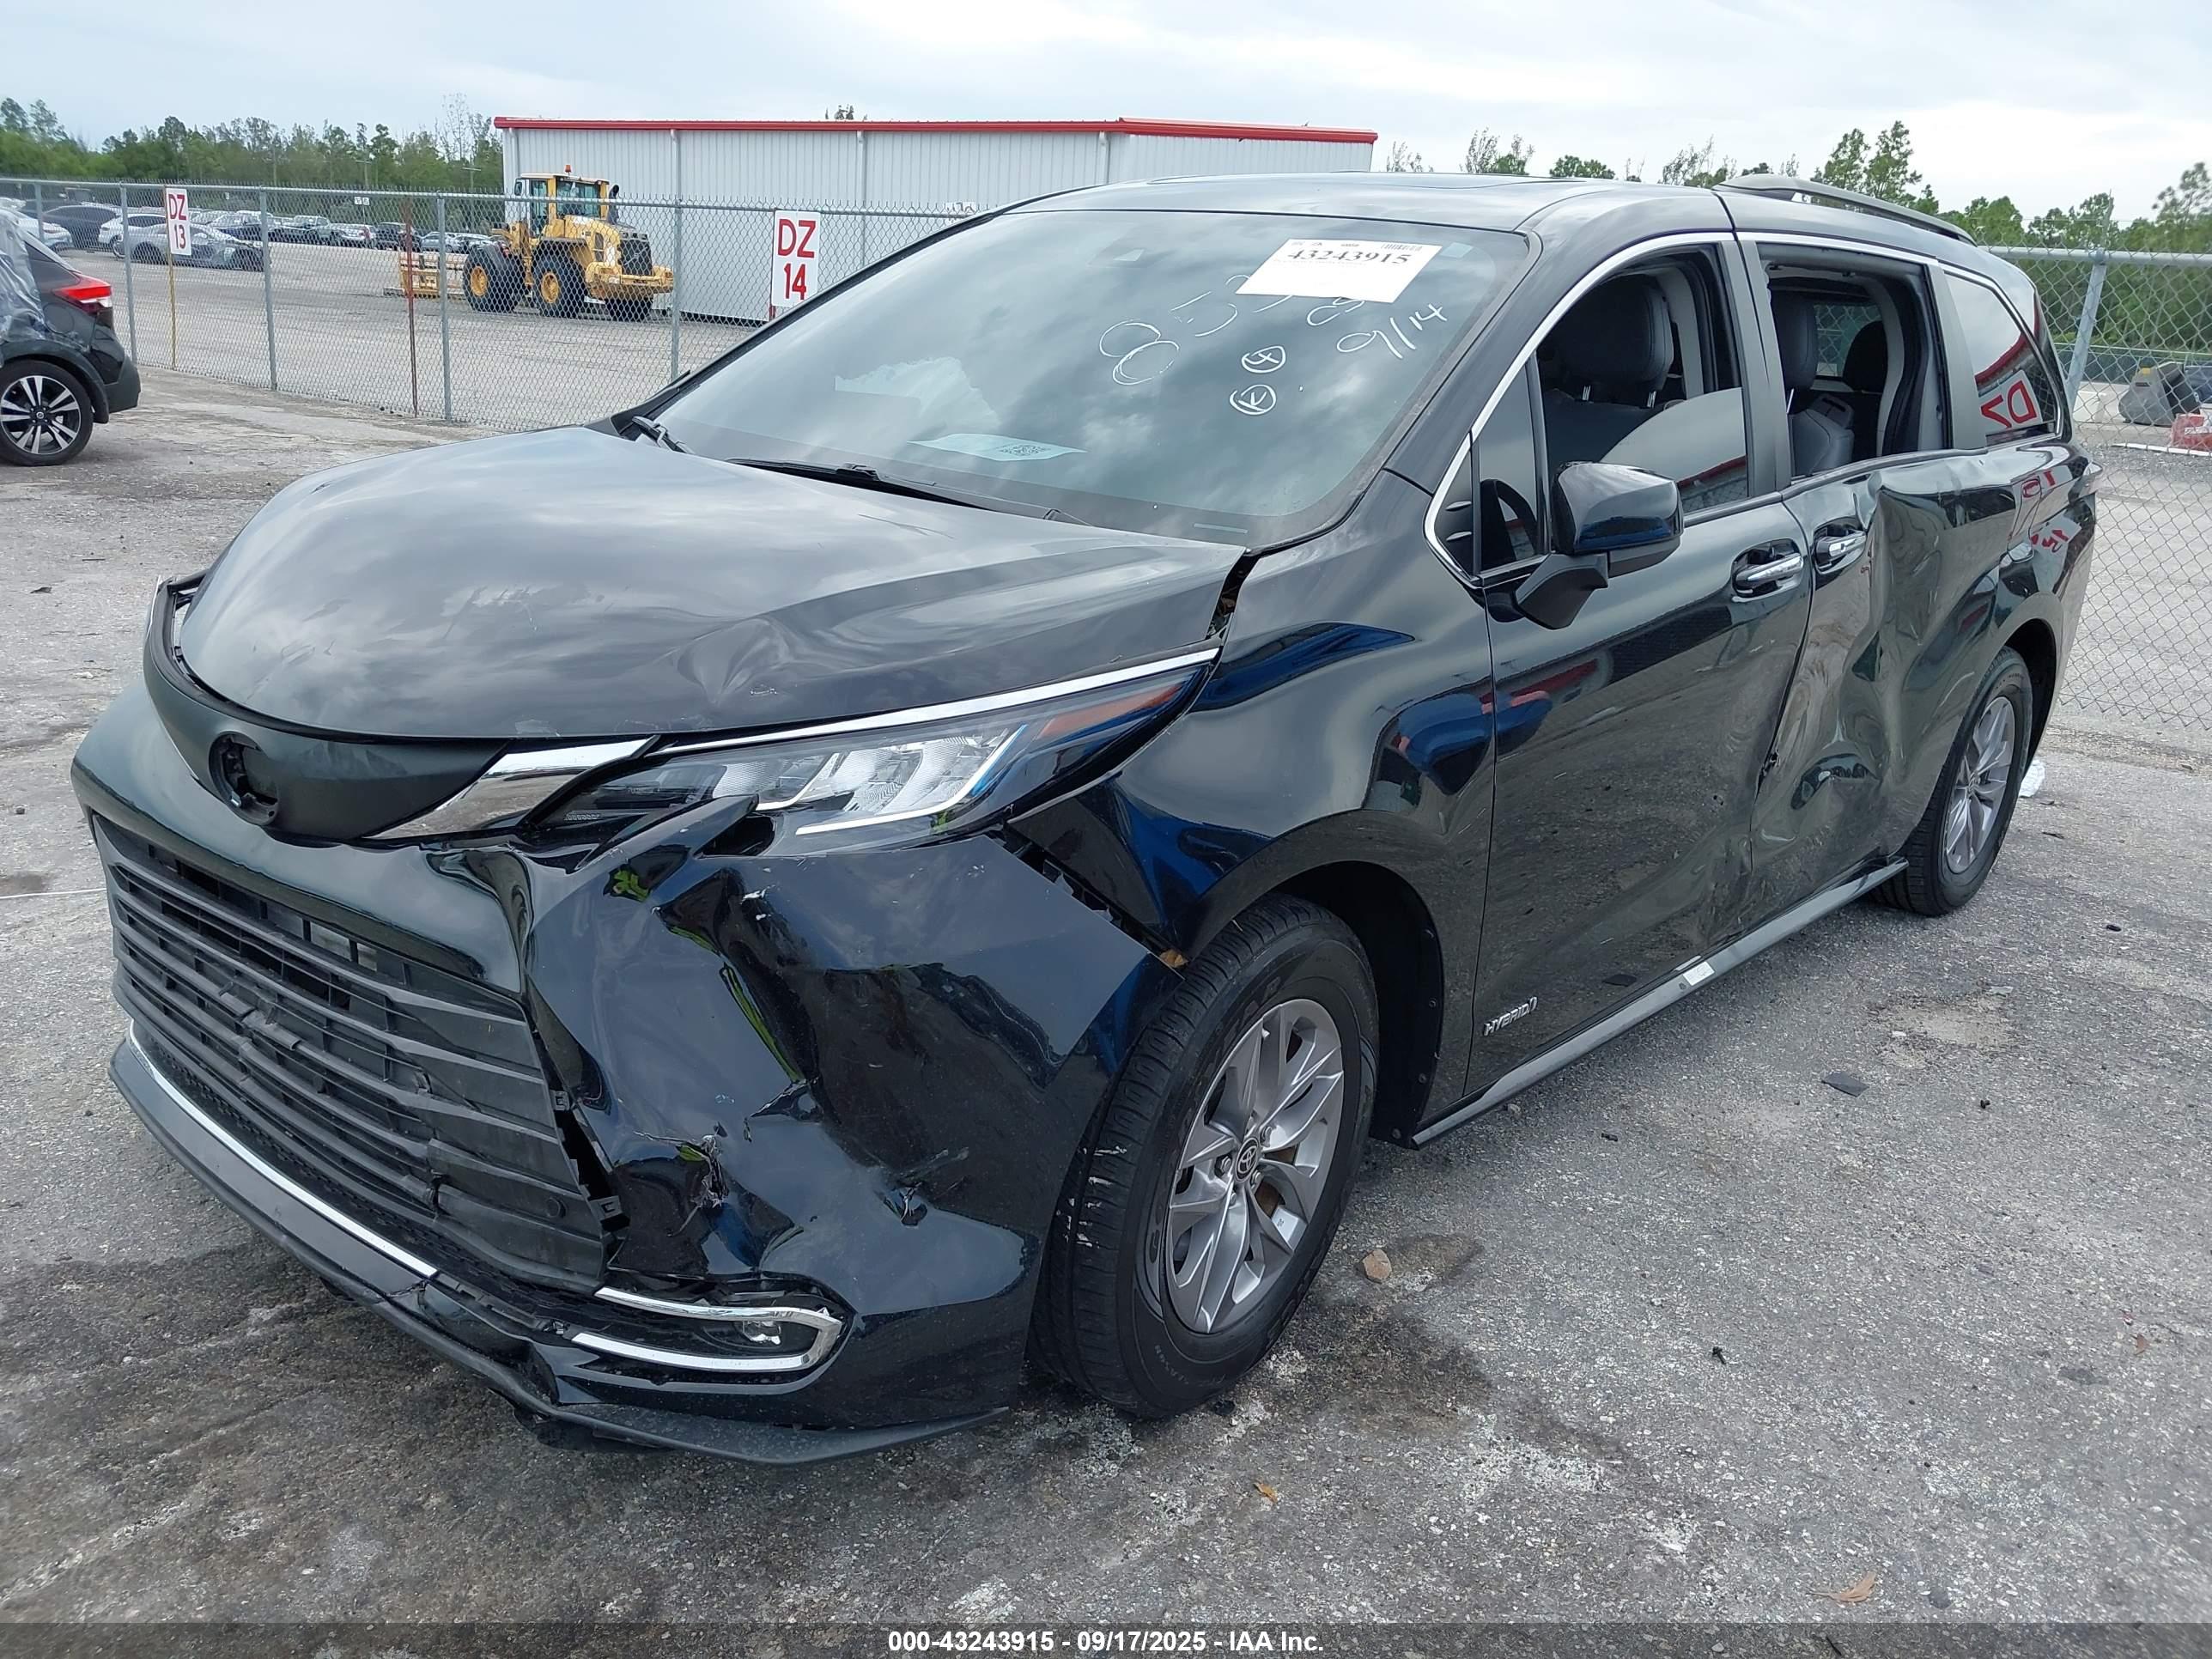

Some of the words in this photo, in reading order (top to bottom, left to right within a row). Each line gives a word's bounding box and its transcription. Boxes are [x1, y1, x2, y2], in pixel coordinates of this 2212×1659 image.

[168, 193, 187, 221] DZ
[174, 224, 186, 249] 13
[778, 218, 817, 258] DZ
[1288, 249, 1412, 265] 43243915
[784, 263, 806, 301] 14
[1336, 303, 1448, 359] 9/14
[1483, 1002, 1530, 1036] HYBRID
